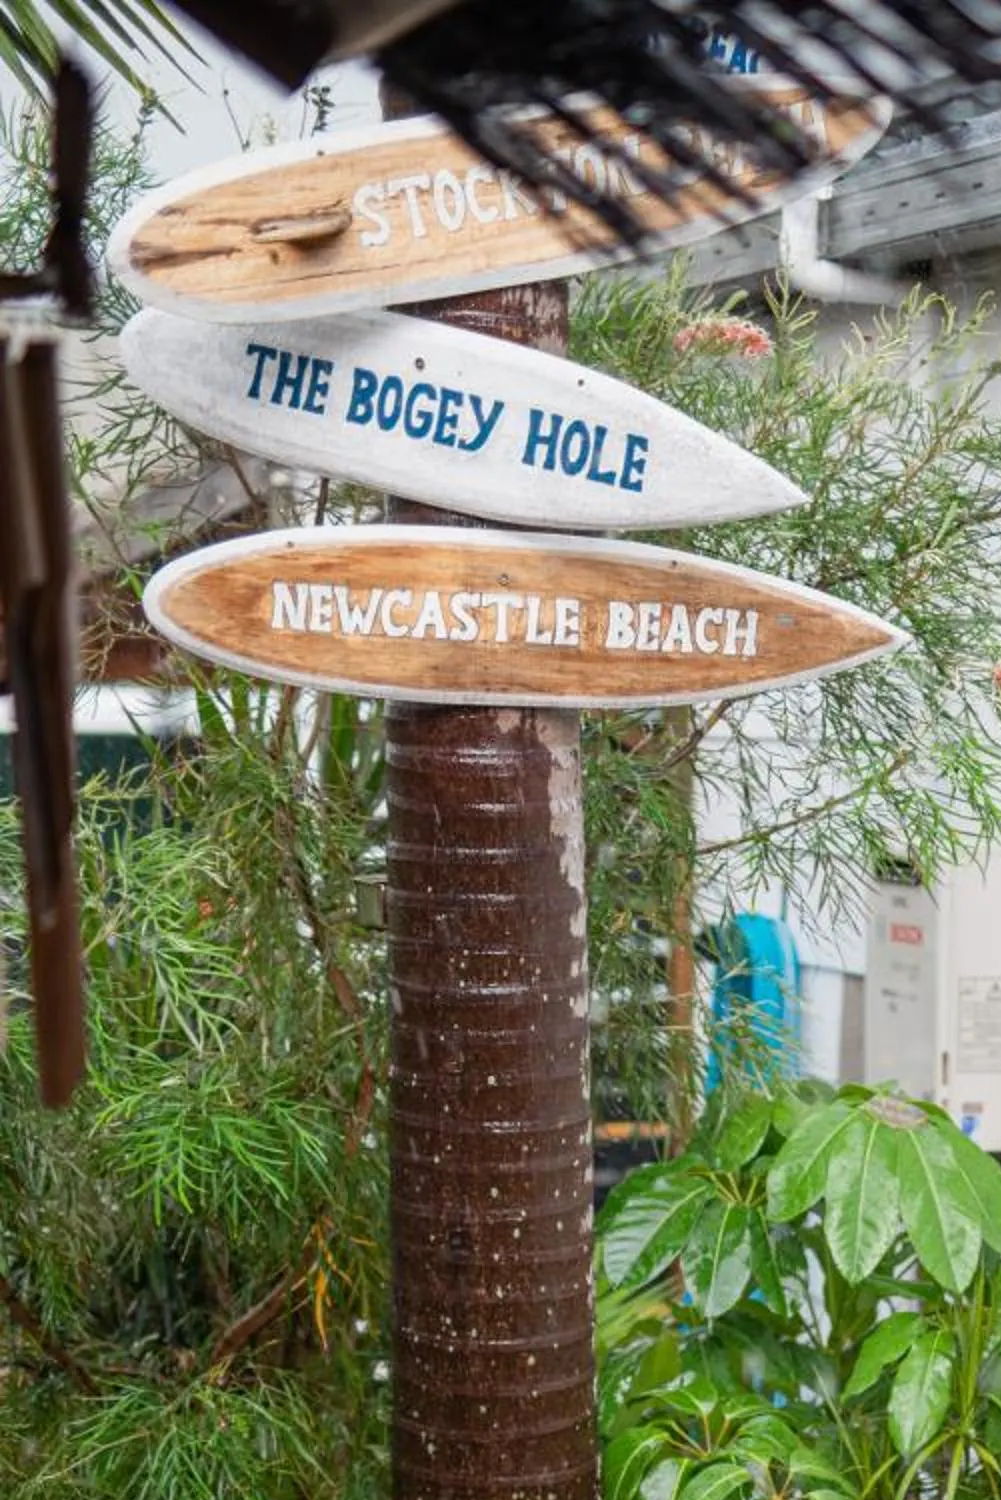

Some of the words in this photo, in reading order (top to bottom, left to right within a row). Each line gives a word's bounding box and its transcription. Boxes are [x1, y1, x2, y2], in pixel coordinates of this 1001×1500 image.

[246, 343, 334, 415] THE
[346, 367, 504, 451] BOGEY
[522, 408, 649, 492] HOLE
[271, 580, 580, 645] NEWCASTLE
[605, 599, 758, 657] BEACH
